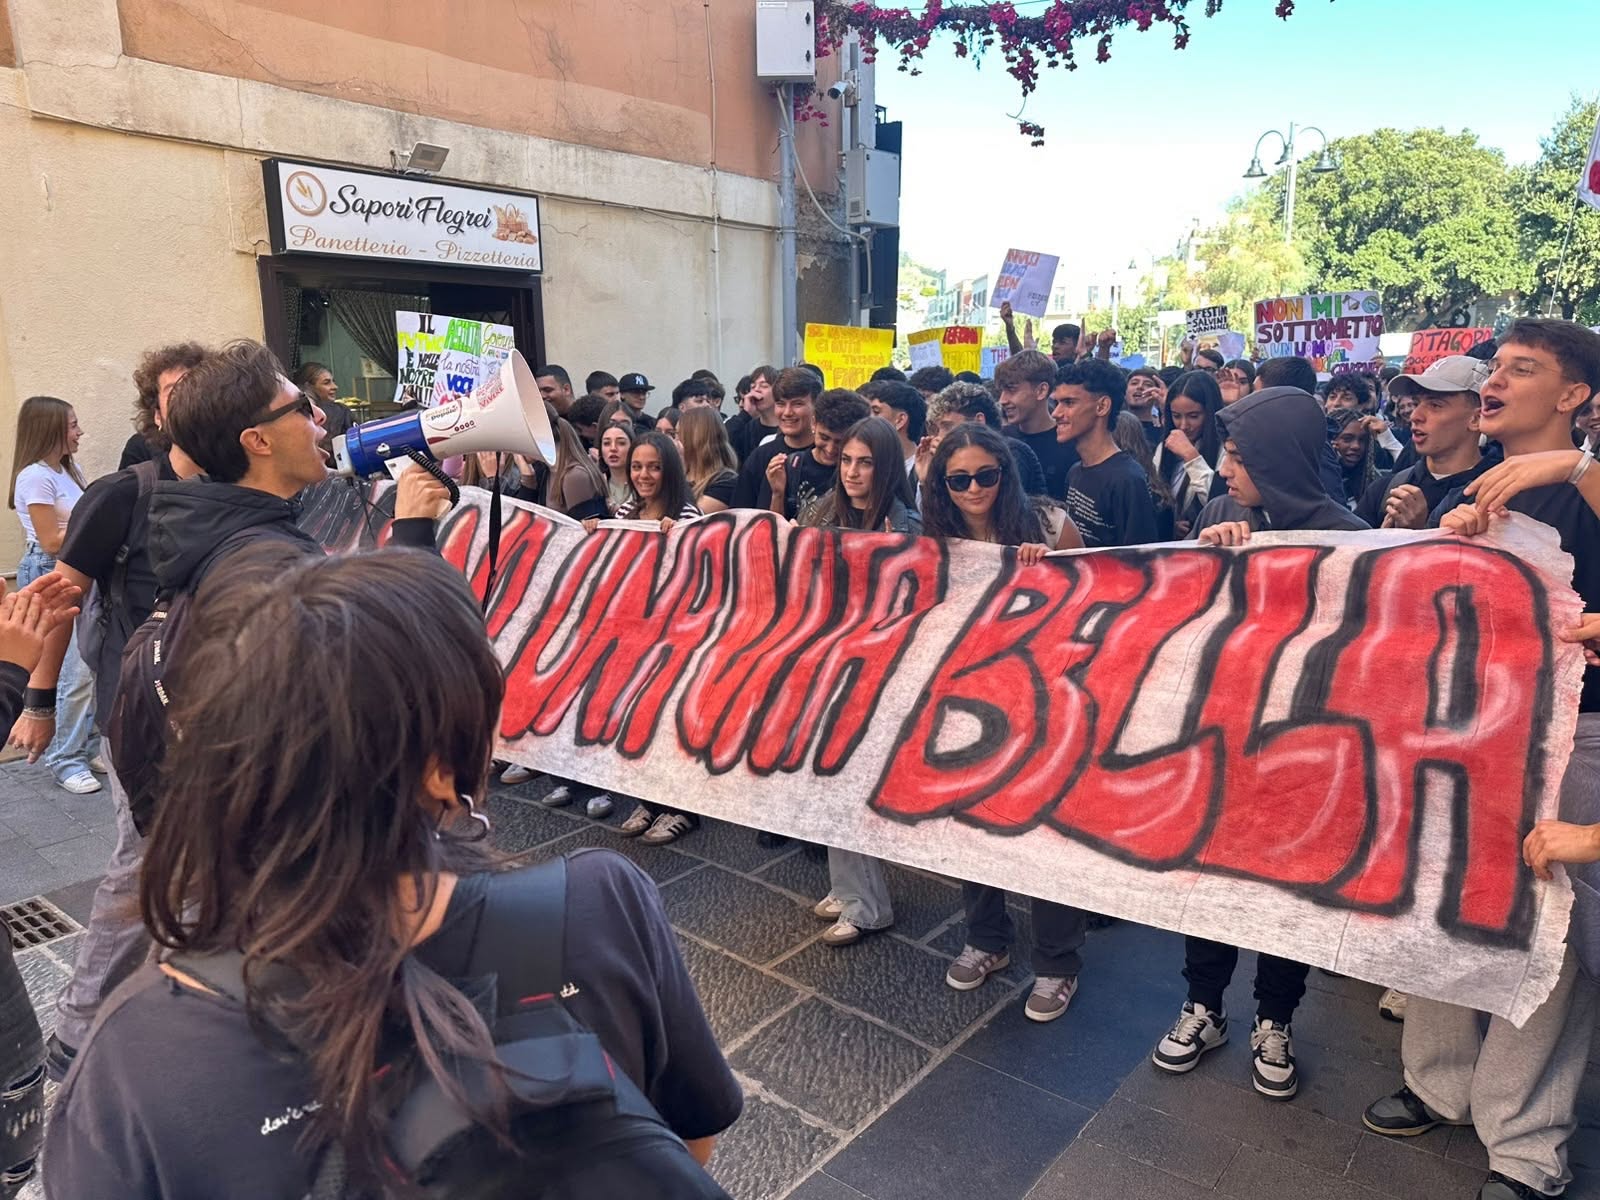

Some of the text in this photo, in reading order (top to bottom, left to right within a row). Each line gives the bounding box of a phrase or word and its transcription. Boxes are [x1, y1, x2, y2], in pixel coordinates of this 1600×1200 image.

[329, 184, 492, 235] Sapori Flegrei
[289, 224, 412, 256] Panetteria
[435, 239, 538, 268] Pizzetteria
[1255, 295, 1343, 323] NON MI
[419, 314, 435, 334] IL
[1257, 315, 1384, 343] SOTTOMETTO
[1270, 342, 1293, 357] UN
[1294, 340, 1333, 357] UOMO
[867, 540, 1556, 950] BELLA
